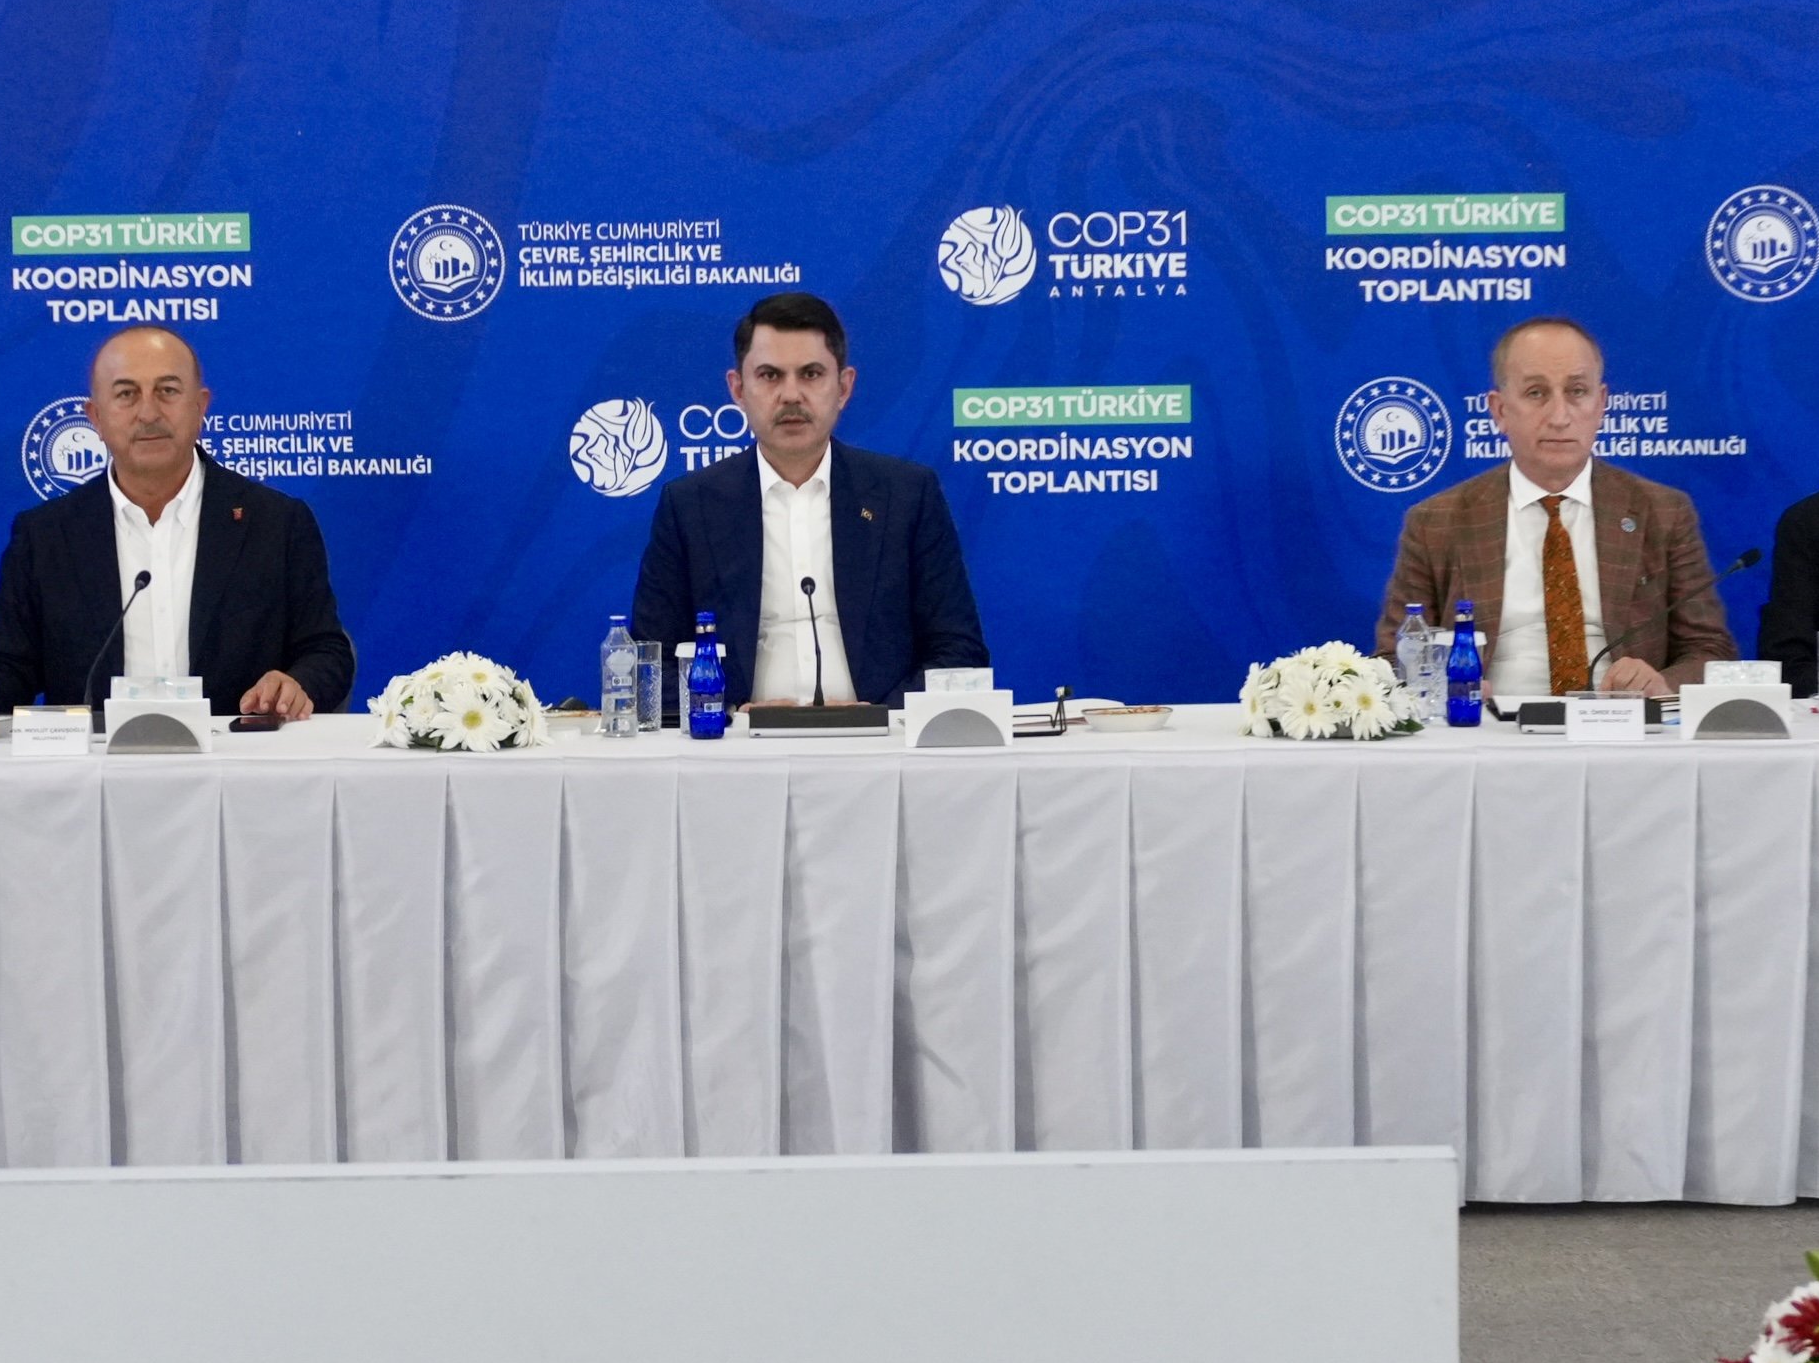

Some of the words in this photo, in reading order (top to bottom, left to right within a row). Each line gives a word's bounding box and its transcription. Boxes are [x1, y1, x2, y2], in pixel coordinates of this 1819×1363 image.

[1335, 204, 1427, 227] COP31
[1432, 195, 1557, 226] TÜRKİYE
[21, 224, 112, 247] COP31
[118, 216, 241, 246] TÜRKİYE
[518, 221, 591, 241] TÜRKİYE
[597, 219, 719, 240] CUMHURİYETİ
[1048, 211, 1186, 248] COP31
[518, 246, 585, 266] ÇEVRE,
[590, 241, 693, 264] ŞEHİRCİLİK
[697, 245, 721, 261] VE
[1326, 240, 1565, 269] KOORDİNASYON
[13, 260, 251, 290] KOORDİNASYON
[520, 266, 572, 286] İKLİM
[578, 264, 690, 290] DEĞİŞİKLİĞİ
[696, 262, 800, 284] BAKANLIĞI
[1050, 284, 1186, 297] ANTALYA
[1359, 278, 1531, 302] TOPLANTISI
[46, 298, 217, 322] TOPLANTISI
[962, 396, 1054, 419] COP31
[1059, 387, 1183, 418] TÜRKİYE
[1604, 391, 1667, 411] RİYETİ
[229, 411, 351, 431] CUMHURİYETİ
[1642, 417, 1669, 434] VE
[222, 433, 325, 458] ŞEHİRCİLİK
[329, 436, 353, 452] VE
[954, 432, 1192, 461] KOORDİNASYON
[1641, 436, 1746, 456] BAKANLIĞI
[217, 456, 323, 482] EĞİŞİKLİĞİ
[328, 455, 431, 475] BAKANLIĞI
[987, 470, 1157, 493] TOPLANTISI
